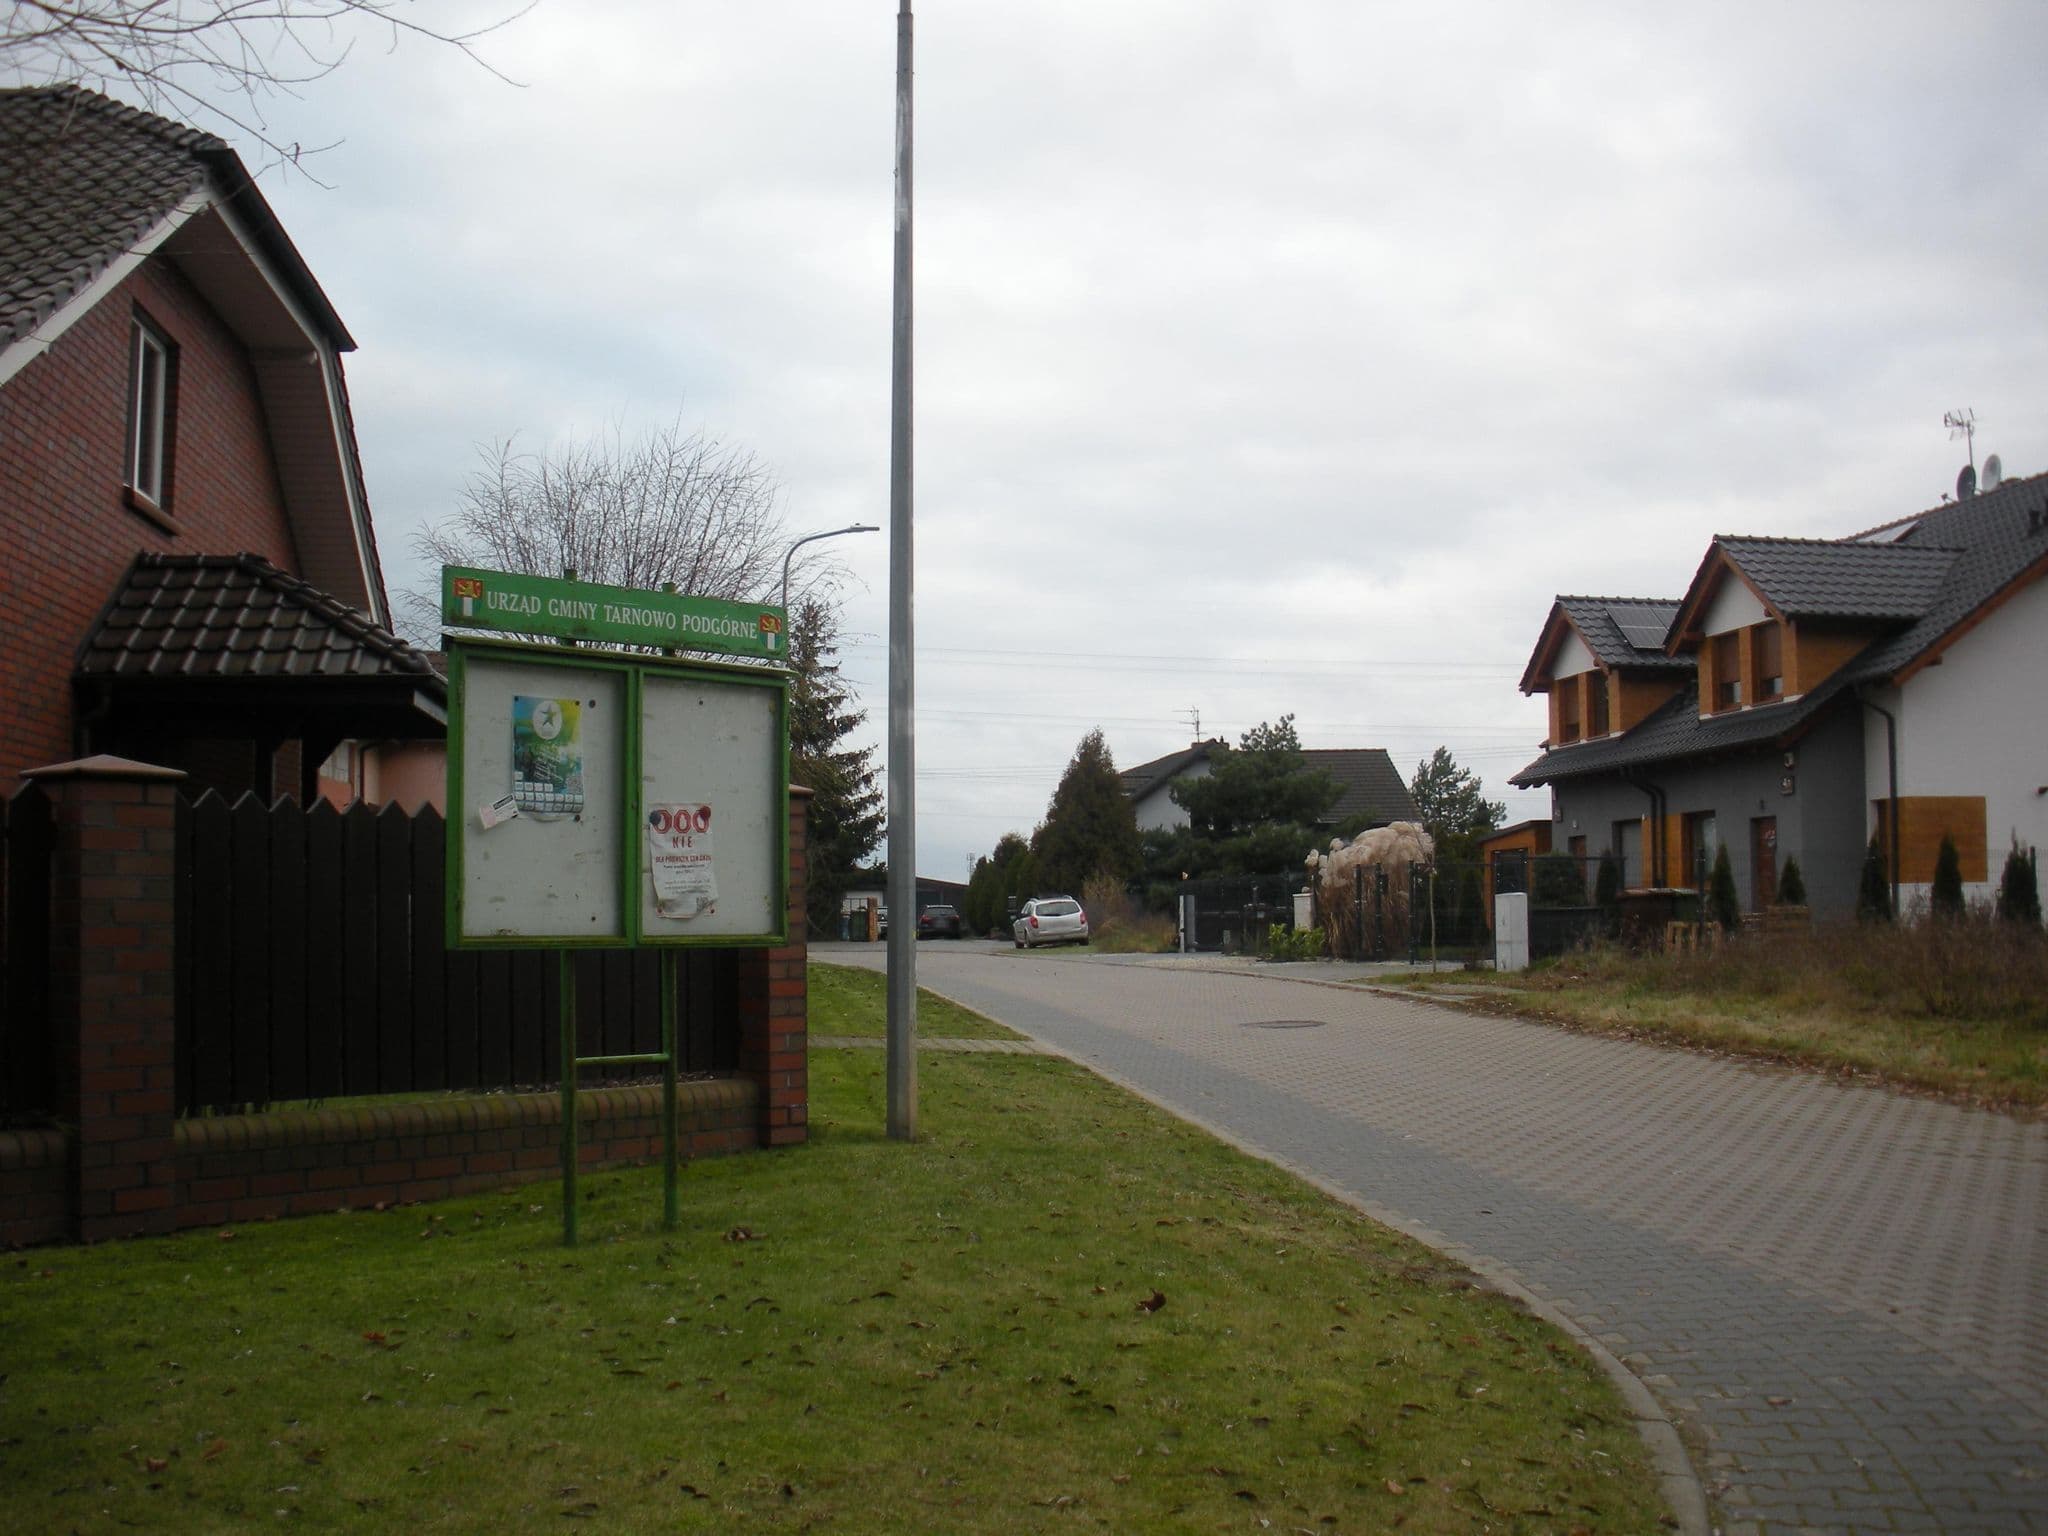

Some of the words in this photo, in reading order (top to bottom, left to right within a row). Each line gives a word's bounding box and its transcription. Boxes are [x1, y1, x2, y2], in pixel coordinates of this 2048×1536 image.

[487, 591, 541, 616] URZĄD
[548, 599, 597, 620] GMINY
[604, 605, 676, 630] TARNOWO
[682, 615, 757, 639] PODGÓRNE
[672, 836, 693, 848] NIE
